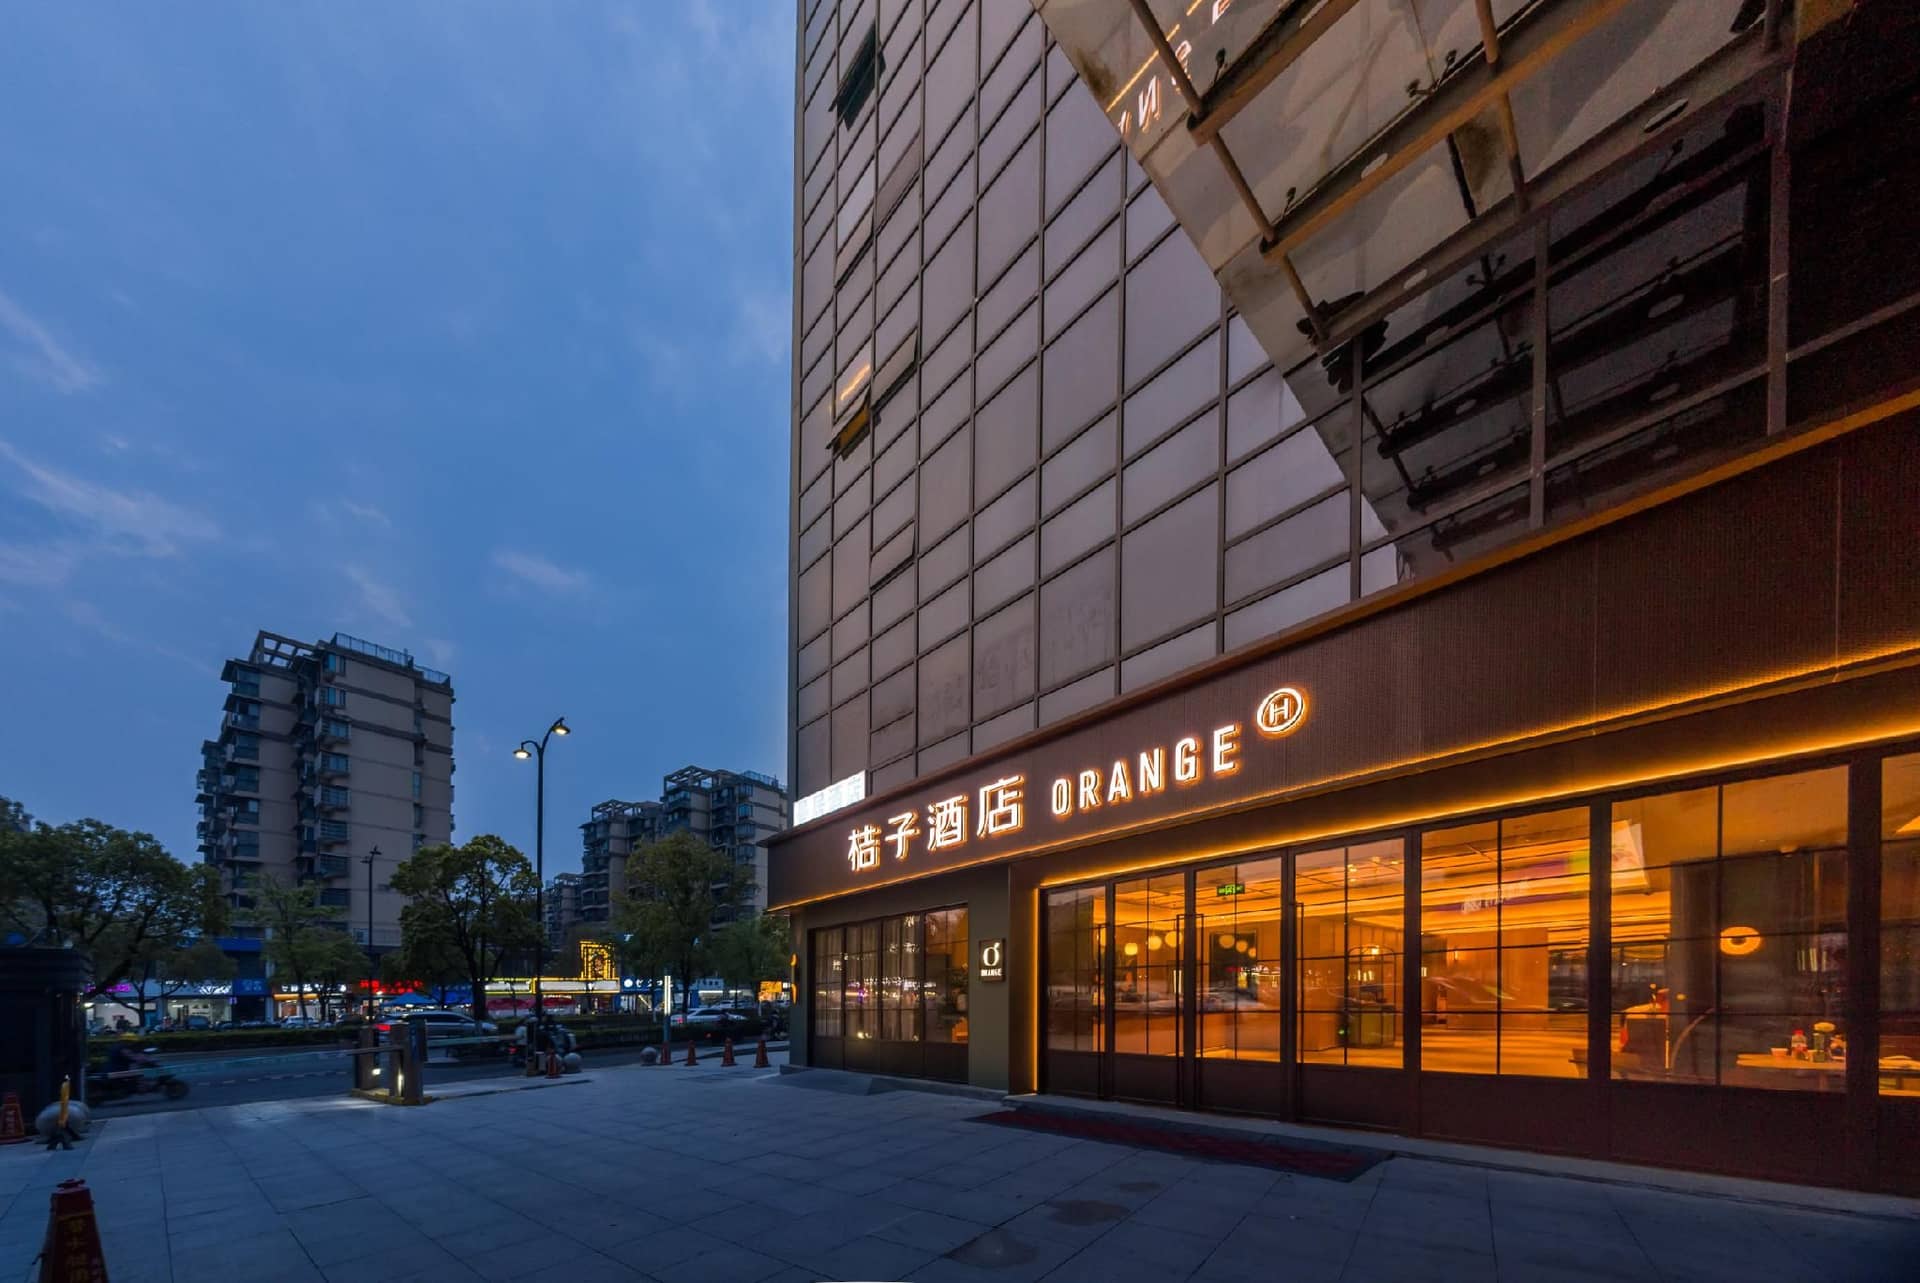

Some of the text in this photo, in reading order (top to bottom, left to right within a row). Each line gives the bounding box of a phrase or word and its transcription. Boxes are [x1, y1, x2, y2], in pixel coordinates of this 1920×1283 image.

[1051, 723, 1240, 816] ORANGE
[847, 775, 1025, 872] 桔子酒店
